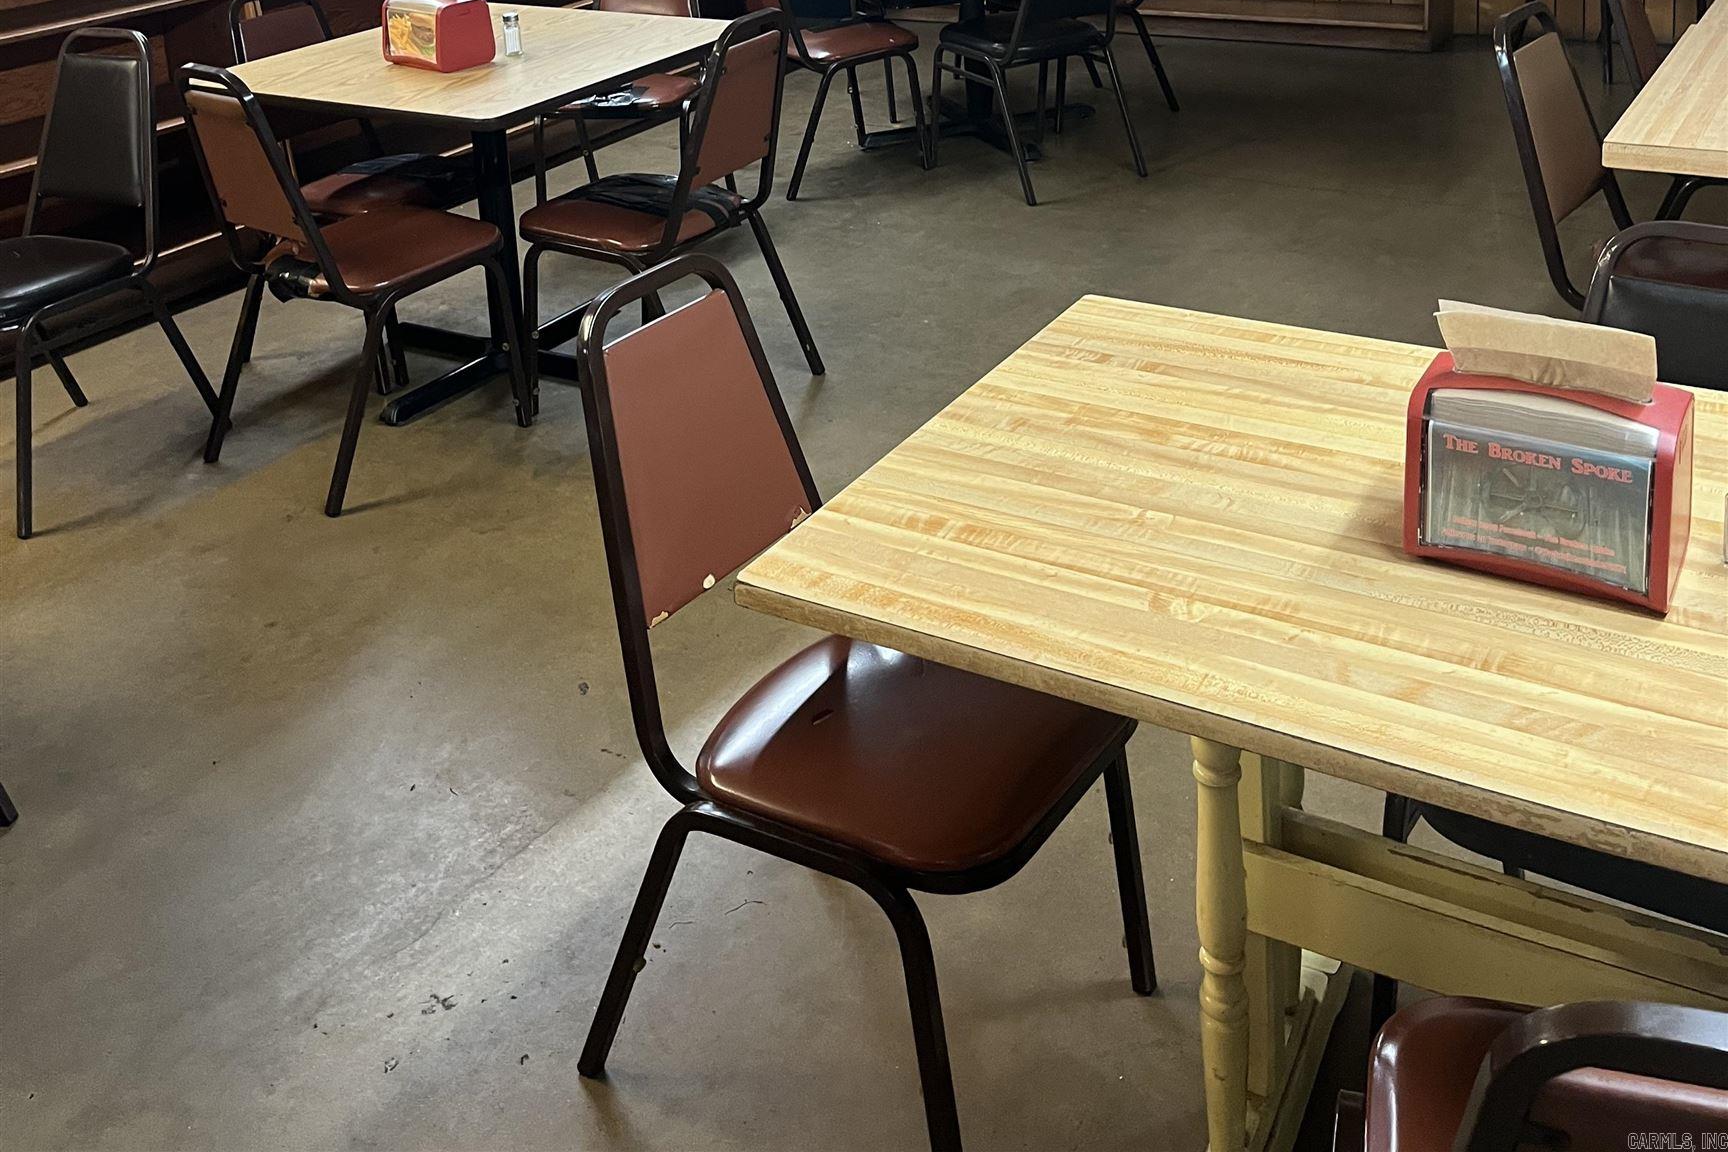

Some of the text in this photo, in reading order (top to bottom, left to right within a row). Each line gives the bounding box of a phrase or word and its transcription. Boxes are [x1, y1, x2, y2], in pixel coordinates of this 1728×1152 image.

[1443, 434, 1633, 484] THE BROKEN SPOKE
